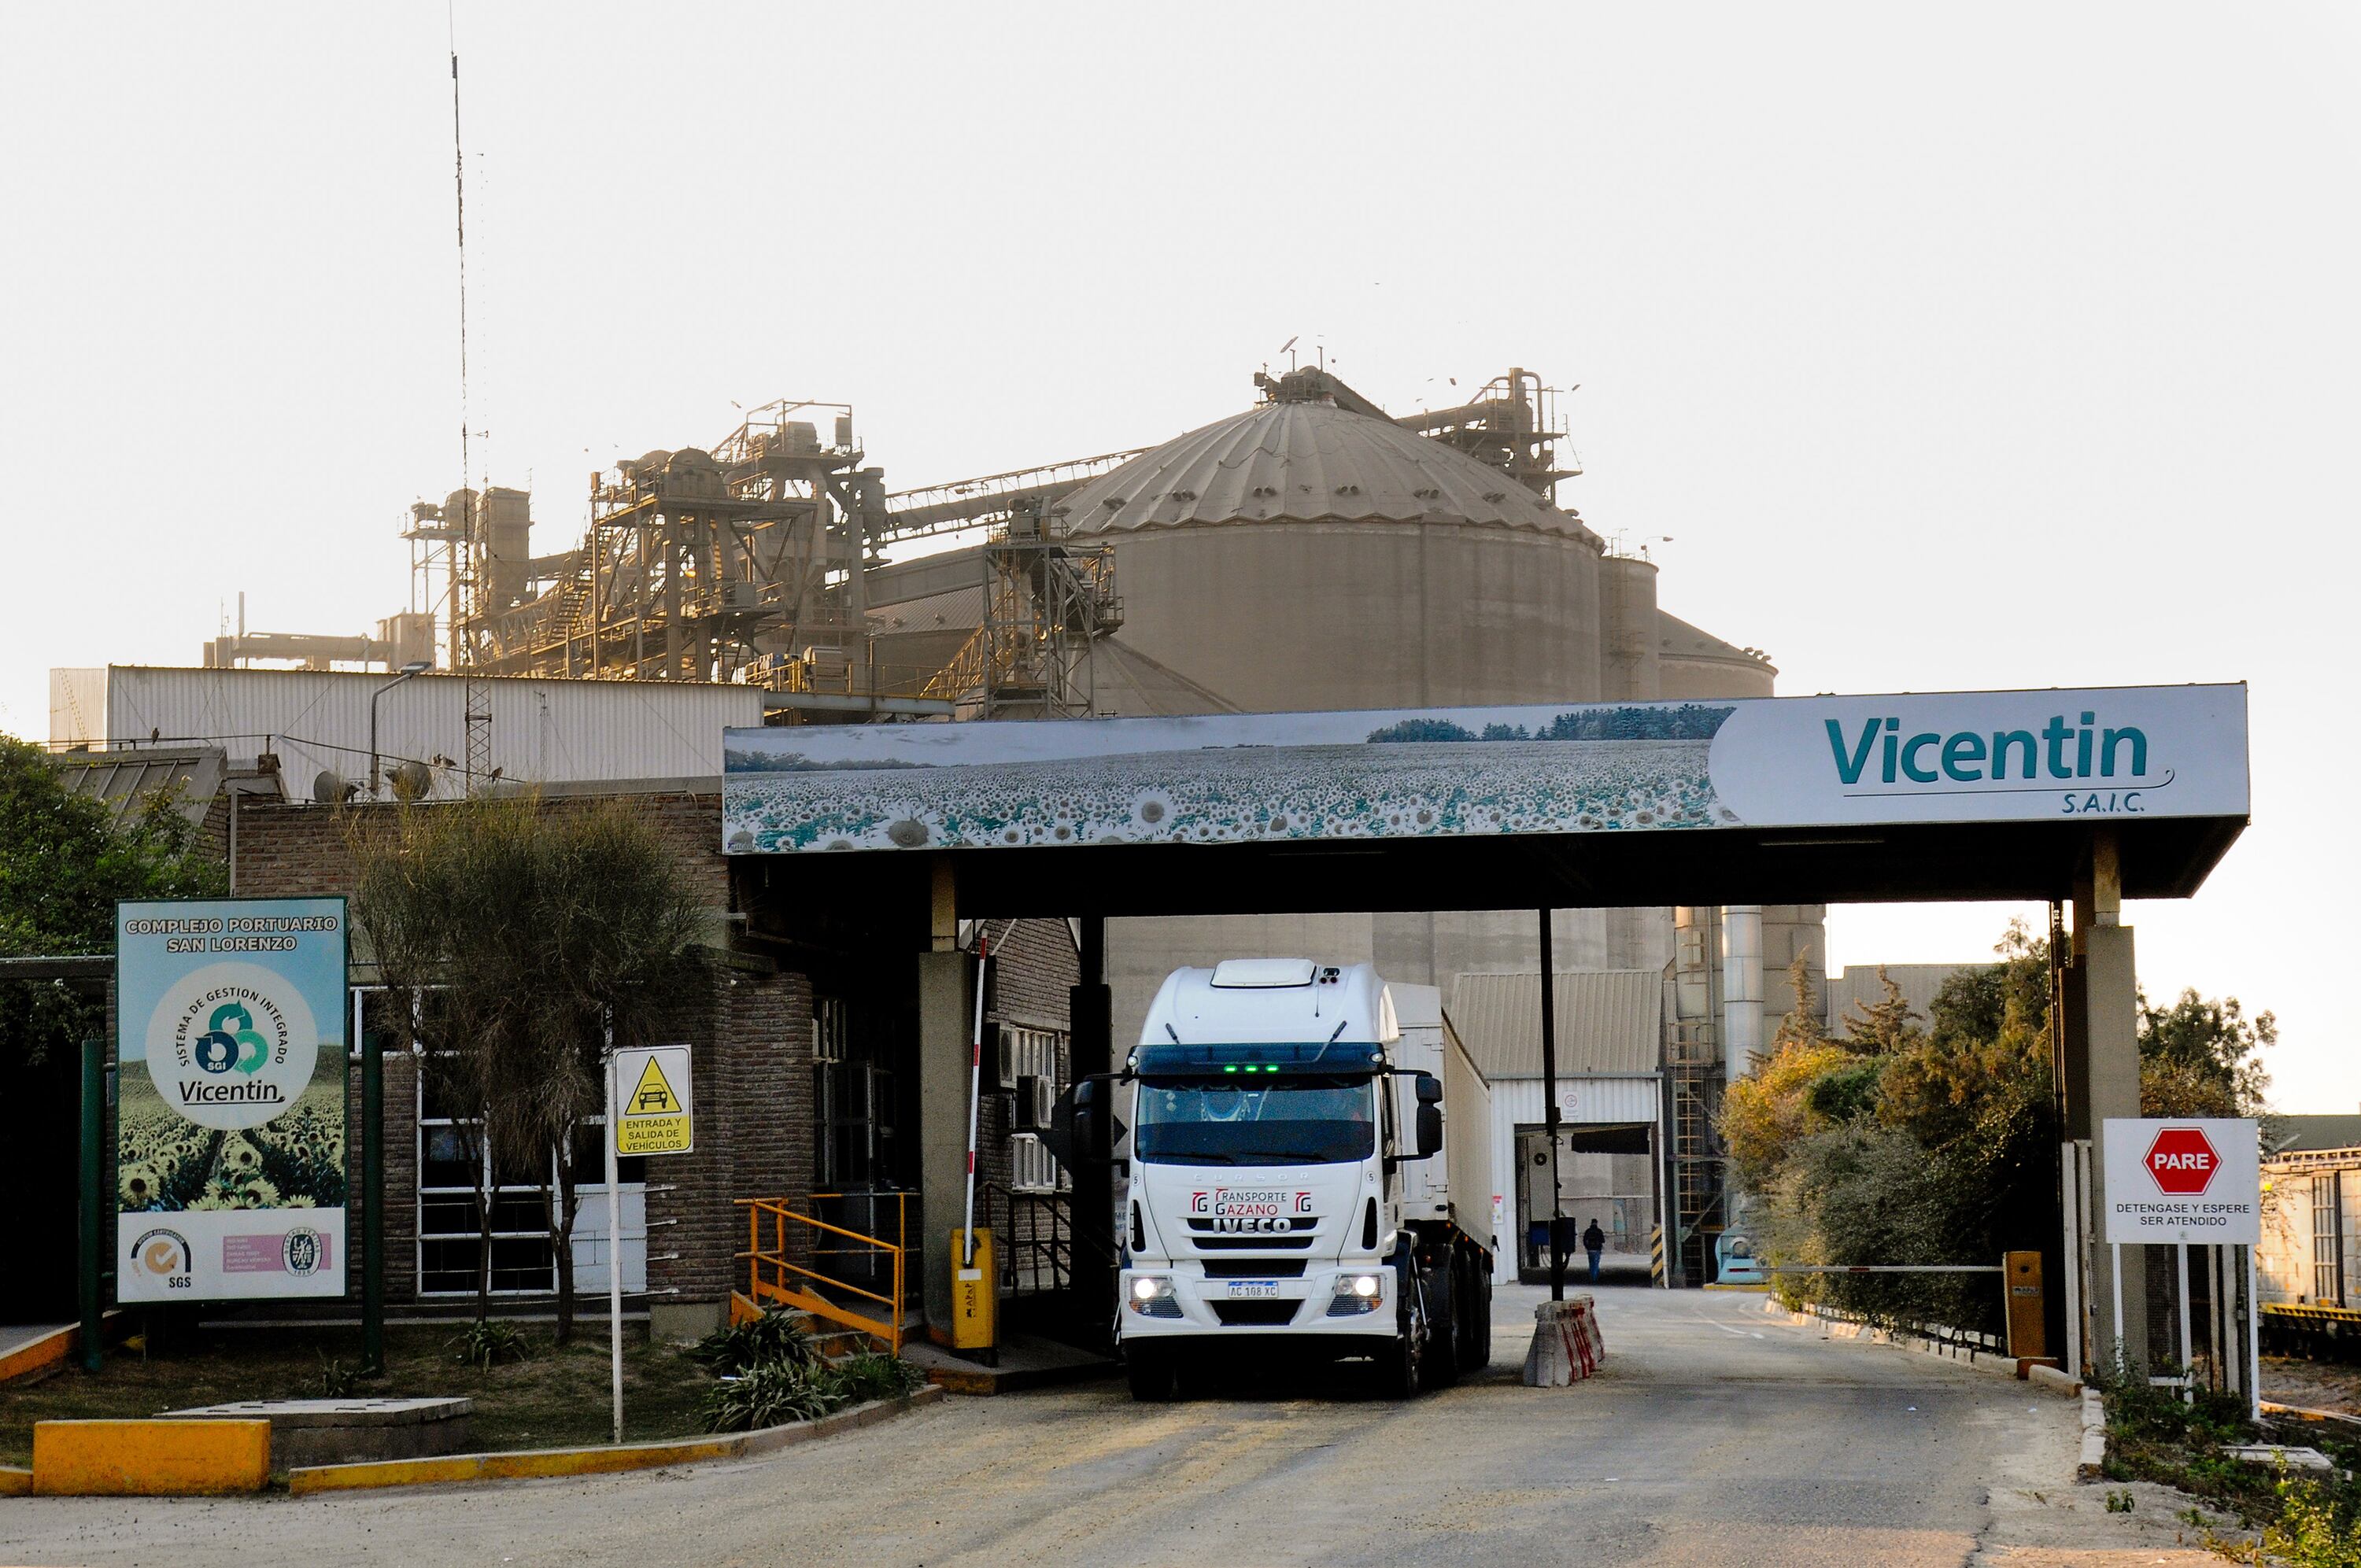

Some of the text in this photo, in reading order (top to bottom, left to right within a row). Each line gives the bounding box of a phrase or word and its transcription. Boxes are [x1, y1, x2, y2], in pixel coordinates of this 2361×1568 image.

[1823, 710, 2148, 784] Vicentin
[2061, 792, 2145, 814] S.A.I.C.
[125, 916, 338, 935] COMPLEJO PORTUARIO
[167, 936, 297, 953] SAN LORENZO
[176, 987, 289, 1067] SISTEMA DE GESTION INTEGRADO
[207, 1061, 227, 1071] SGI
[179, 1079, 279, 1101] Vicentin
[626, 1119, 673, 1129] ENTRADA
[628, 1130, 664, 1140] SALIDA
[2154, 1153, 2211, 1170] PARE
[1215, 1188, 1287, 1202] TRANSPORTE
[1215, 1202, 1278, 1216] GAZANO
[2116, 1204, 2250, 1214] DETENGASE Y ESPERE
[1212, 1218, 1292, 1234] IVECO
[2141, 1216, 2227, 1226] SER ATENDIDO
[168, 1277, 191, 1288] SGS
[1231, 1287, 1242, 1297] AC
[1265, 1287, 1276, 1297] XC
